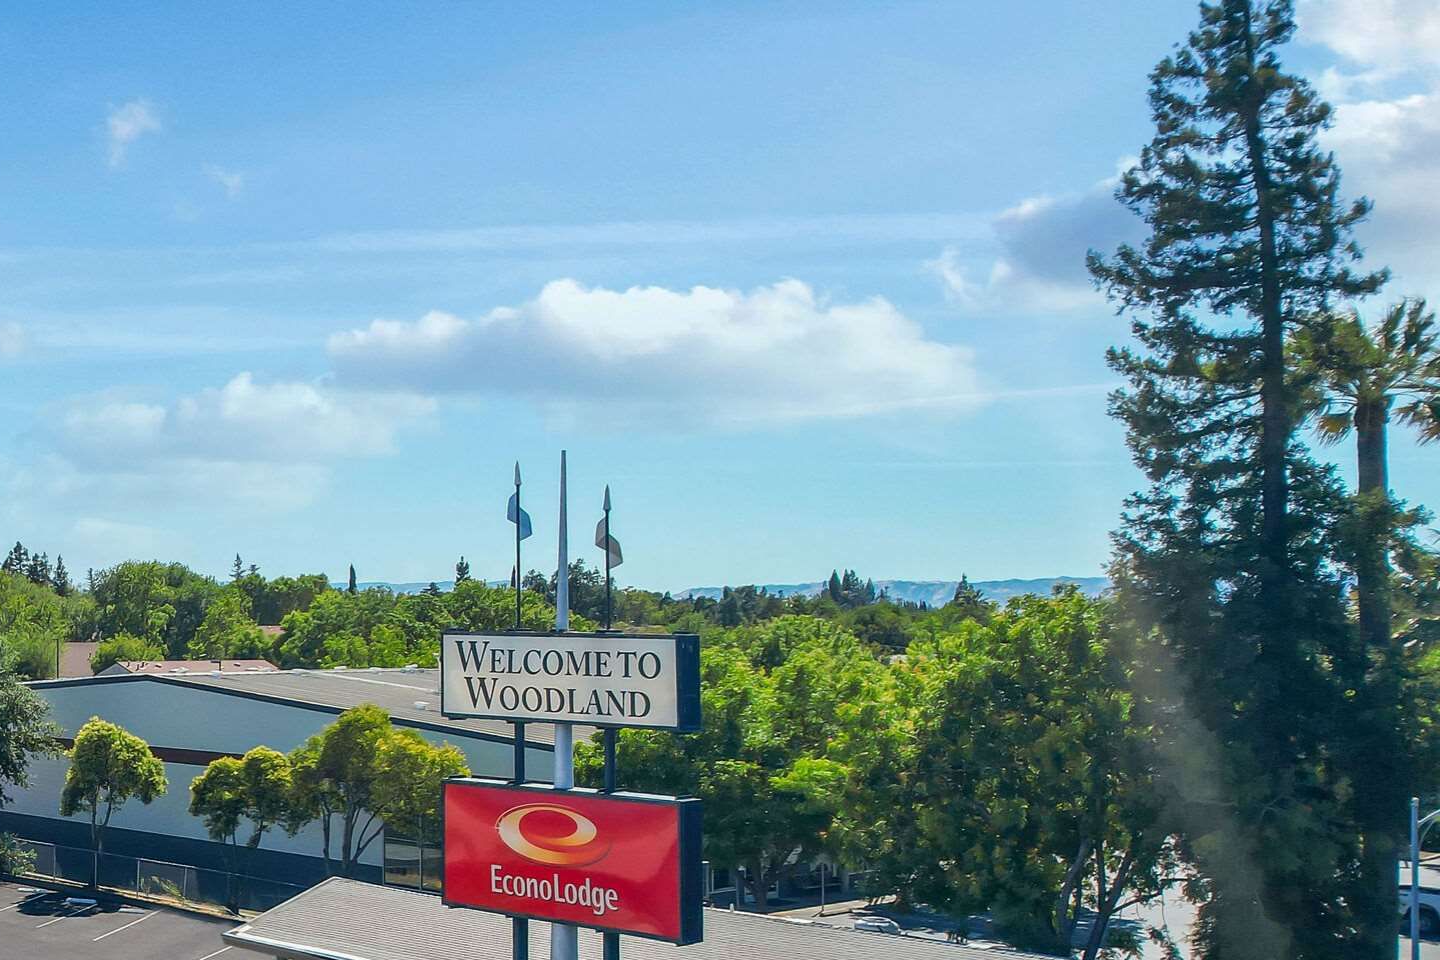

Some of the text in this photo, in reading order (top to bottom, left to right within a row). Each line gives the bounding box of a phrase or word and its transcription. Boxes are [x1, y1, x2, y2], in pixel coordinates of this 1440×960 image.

[455, 640, 662, 680] WELCOME TO
[464, 676, 651, 718] WOODLAND
[490, 864, 620, 915] EconoLodge
